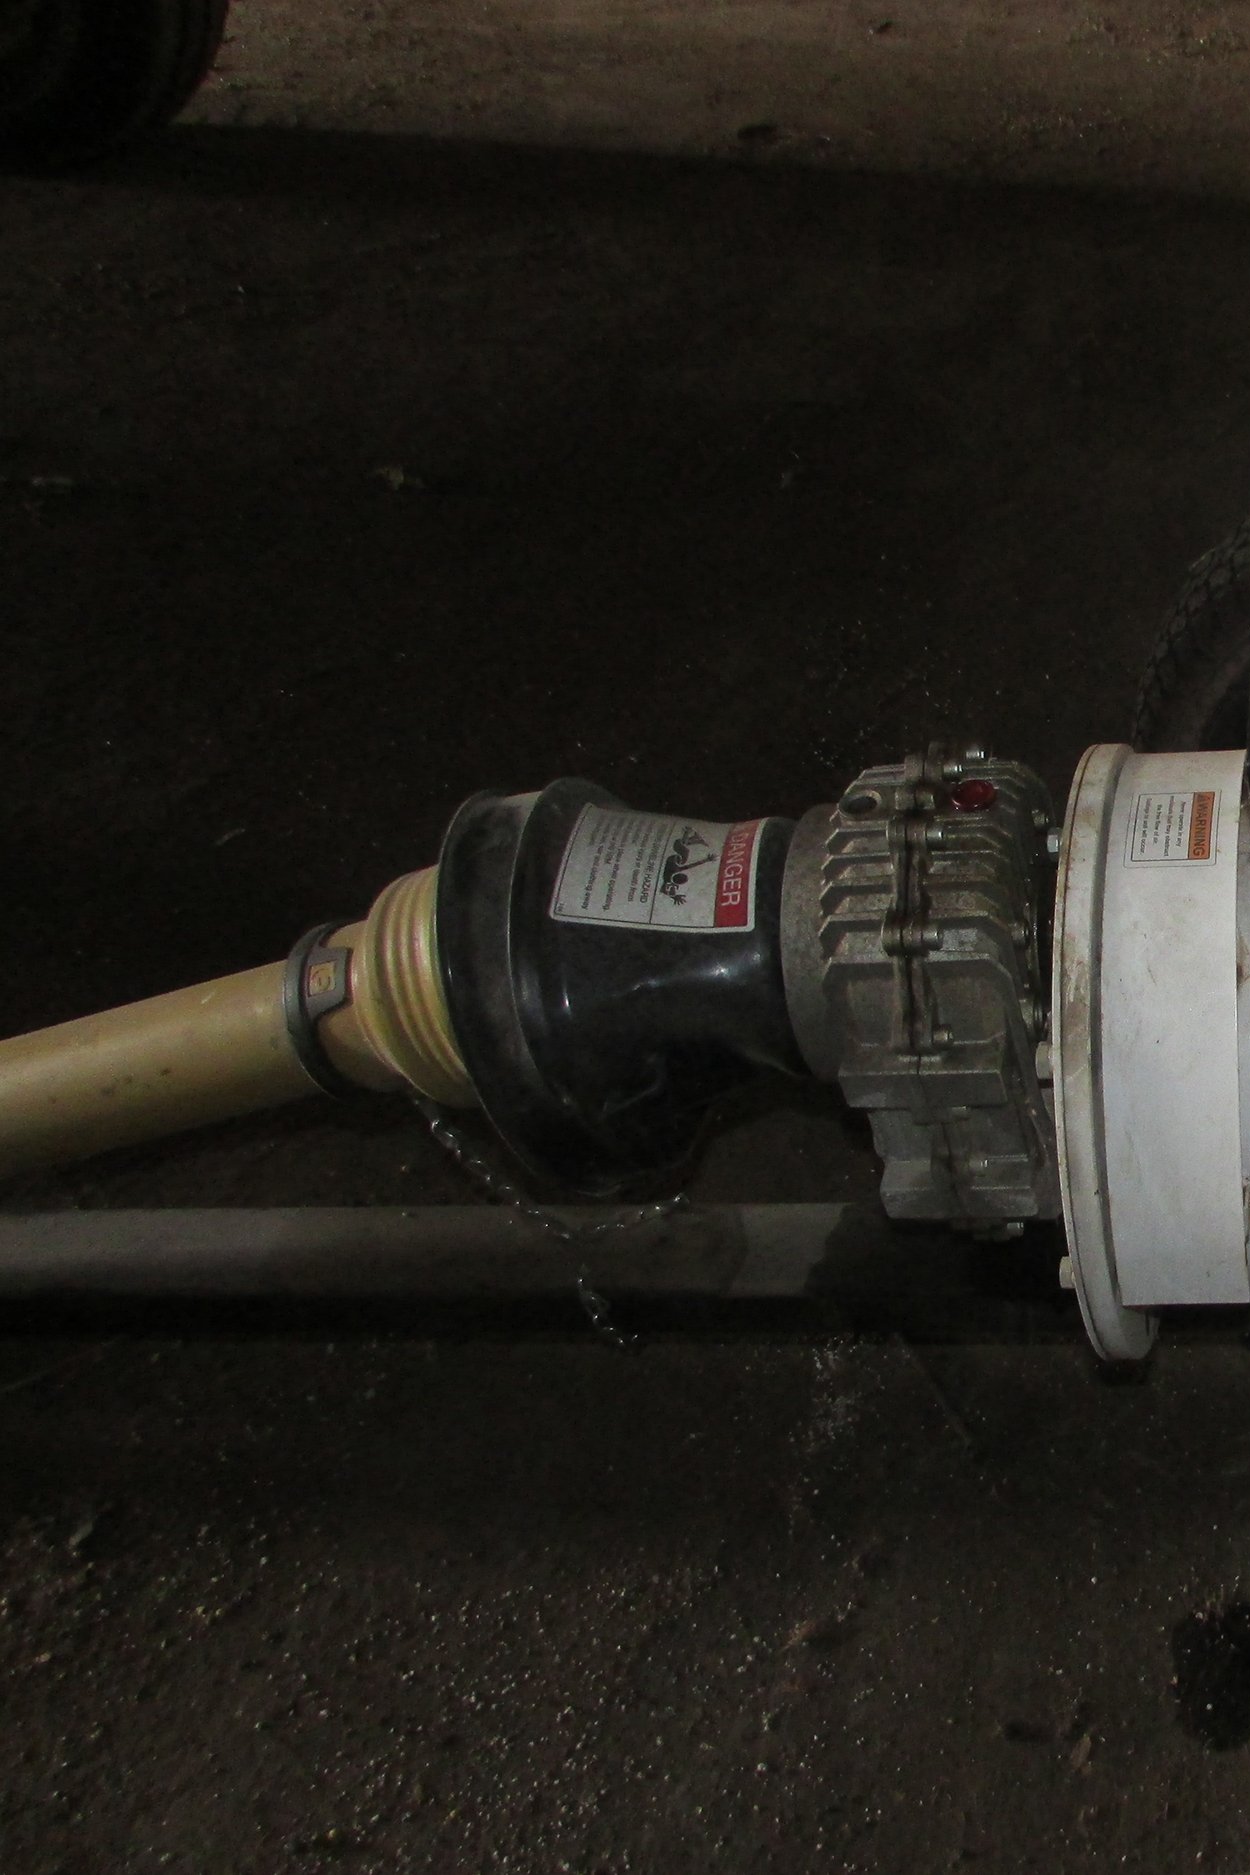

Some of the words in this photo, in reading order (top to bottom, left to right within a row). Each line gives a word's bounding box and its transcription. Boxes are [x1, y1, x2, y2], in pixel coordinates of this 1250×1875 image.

[1193, 802, 1207, 856] WARNING
[639, 873, 652, 903] HAZARD
[721, 831, 748, 907] DANGER
[581, 891, 591, 910] away
